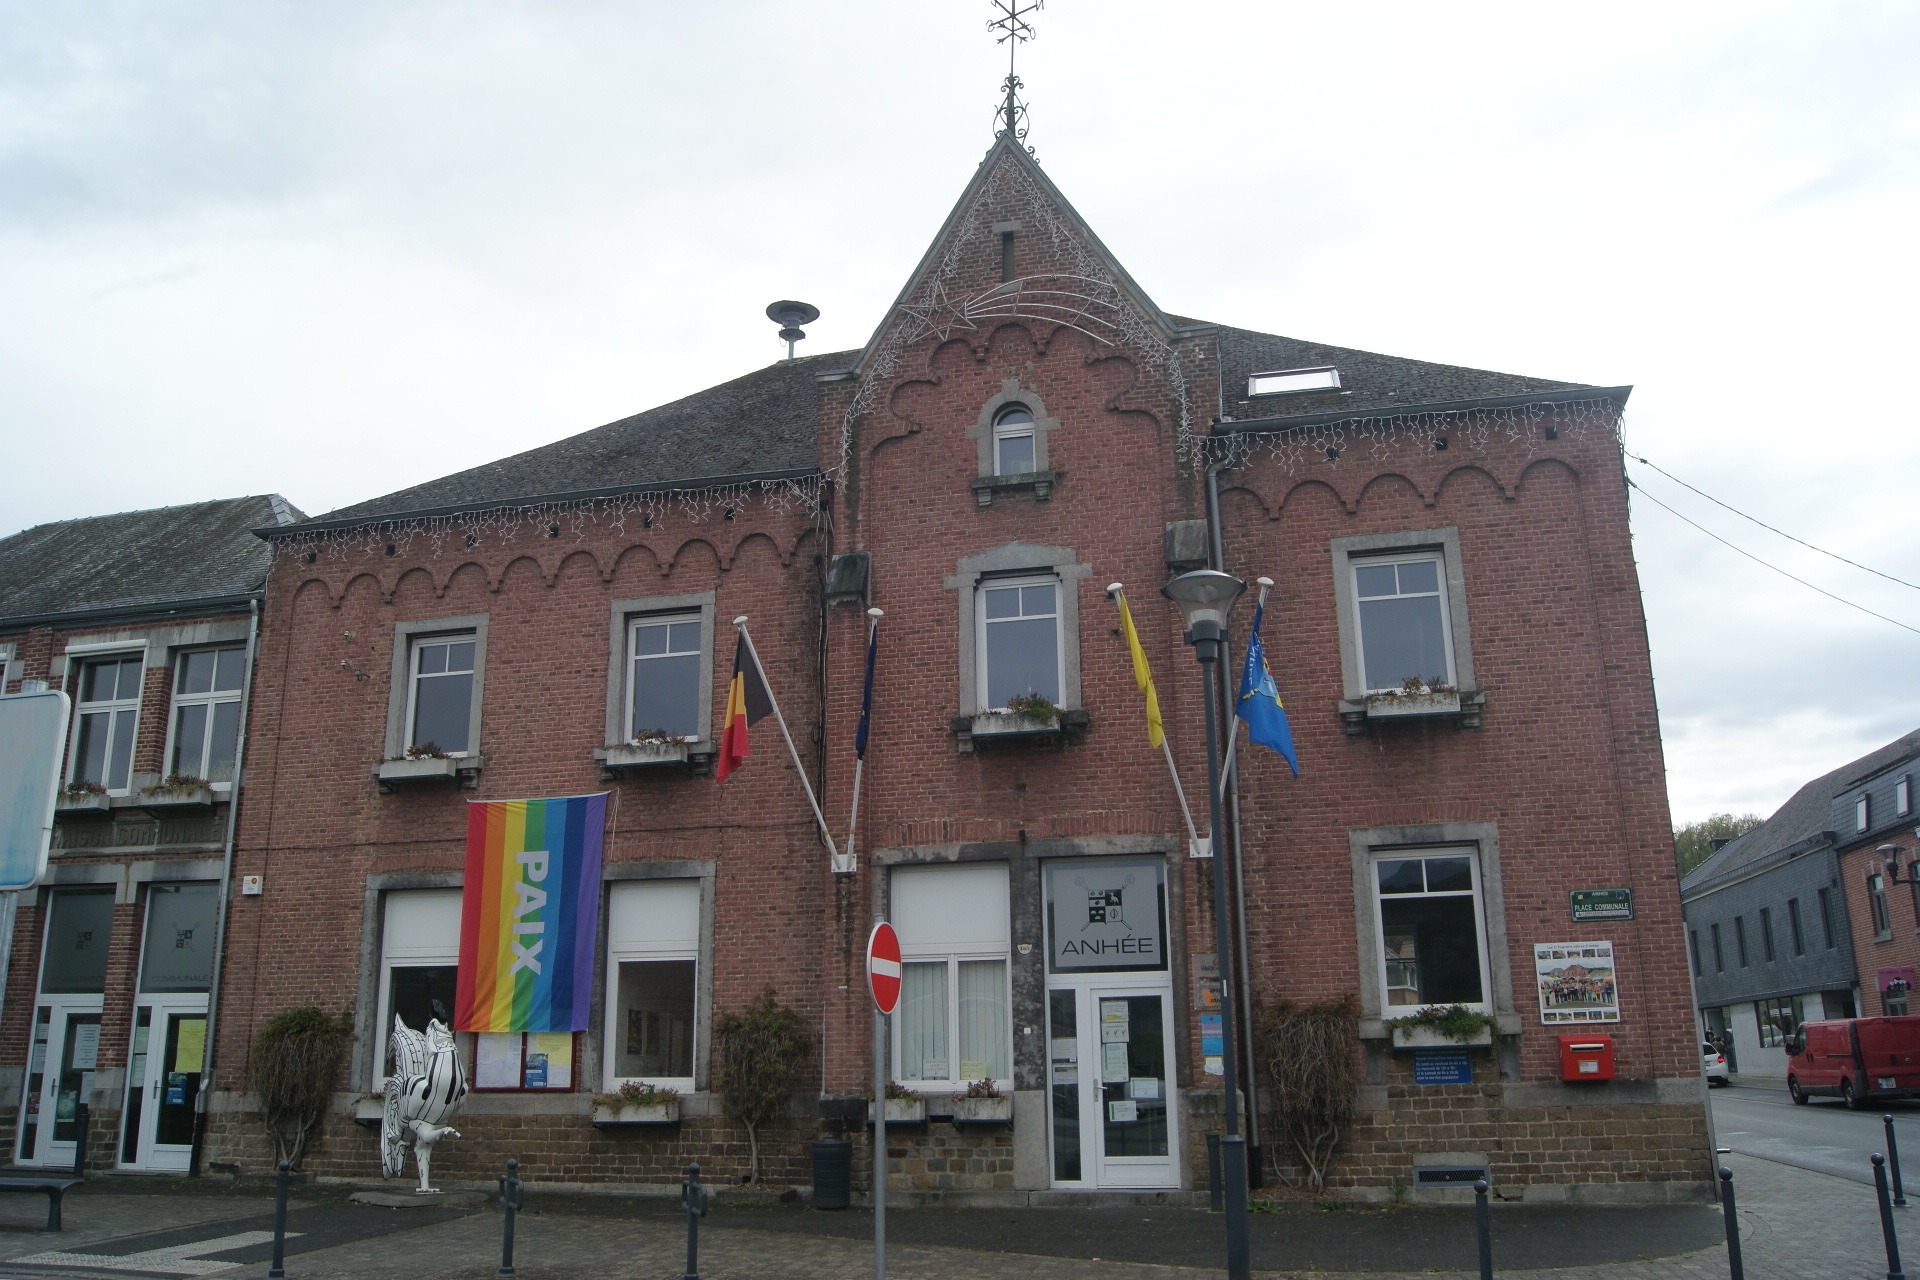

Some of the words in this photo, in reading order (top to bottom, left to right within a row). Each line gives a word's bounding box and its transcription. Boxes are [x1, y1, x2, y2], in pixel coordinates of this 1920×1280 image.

[117, 820, 222, 847] COMMUNALE
[509, 850, 550, 977] PAIX
[1574, 904, 1593, 912] PLACE
[1594, 902, 1629, 911] COMMUNALE
[1061, 934, 1153, 956] ANHÉE
[151, 974, 209, 983] COMMUNALE
